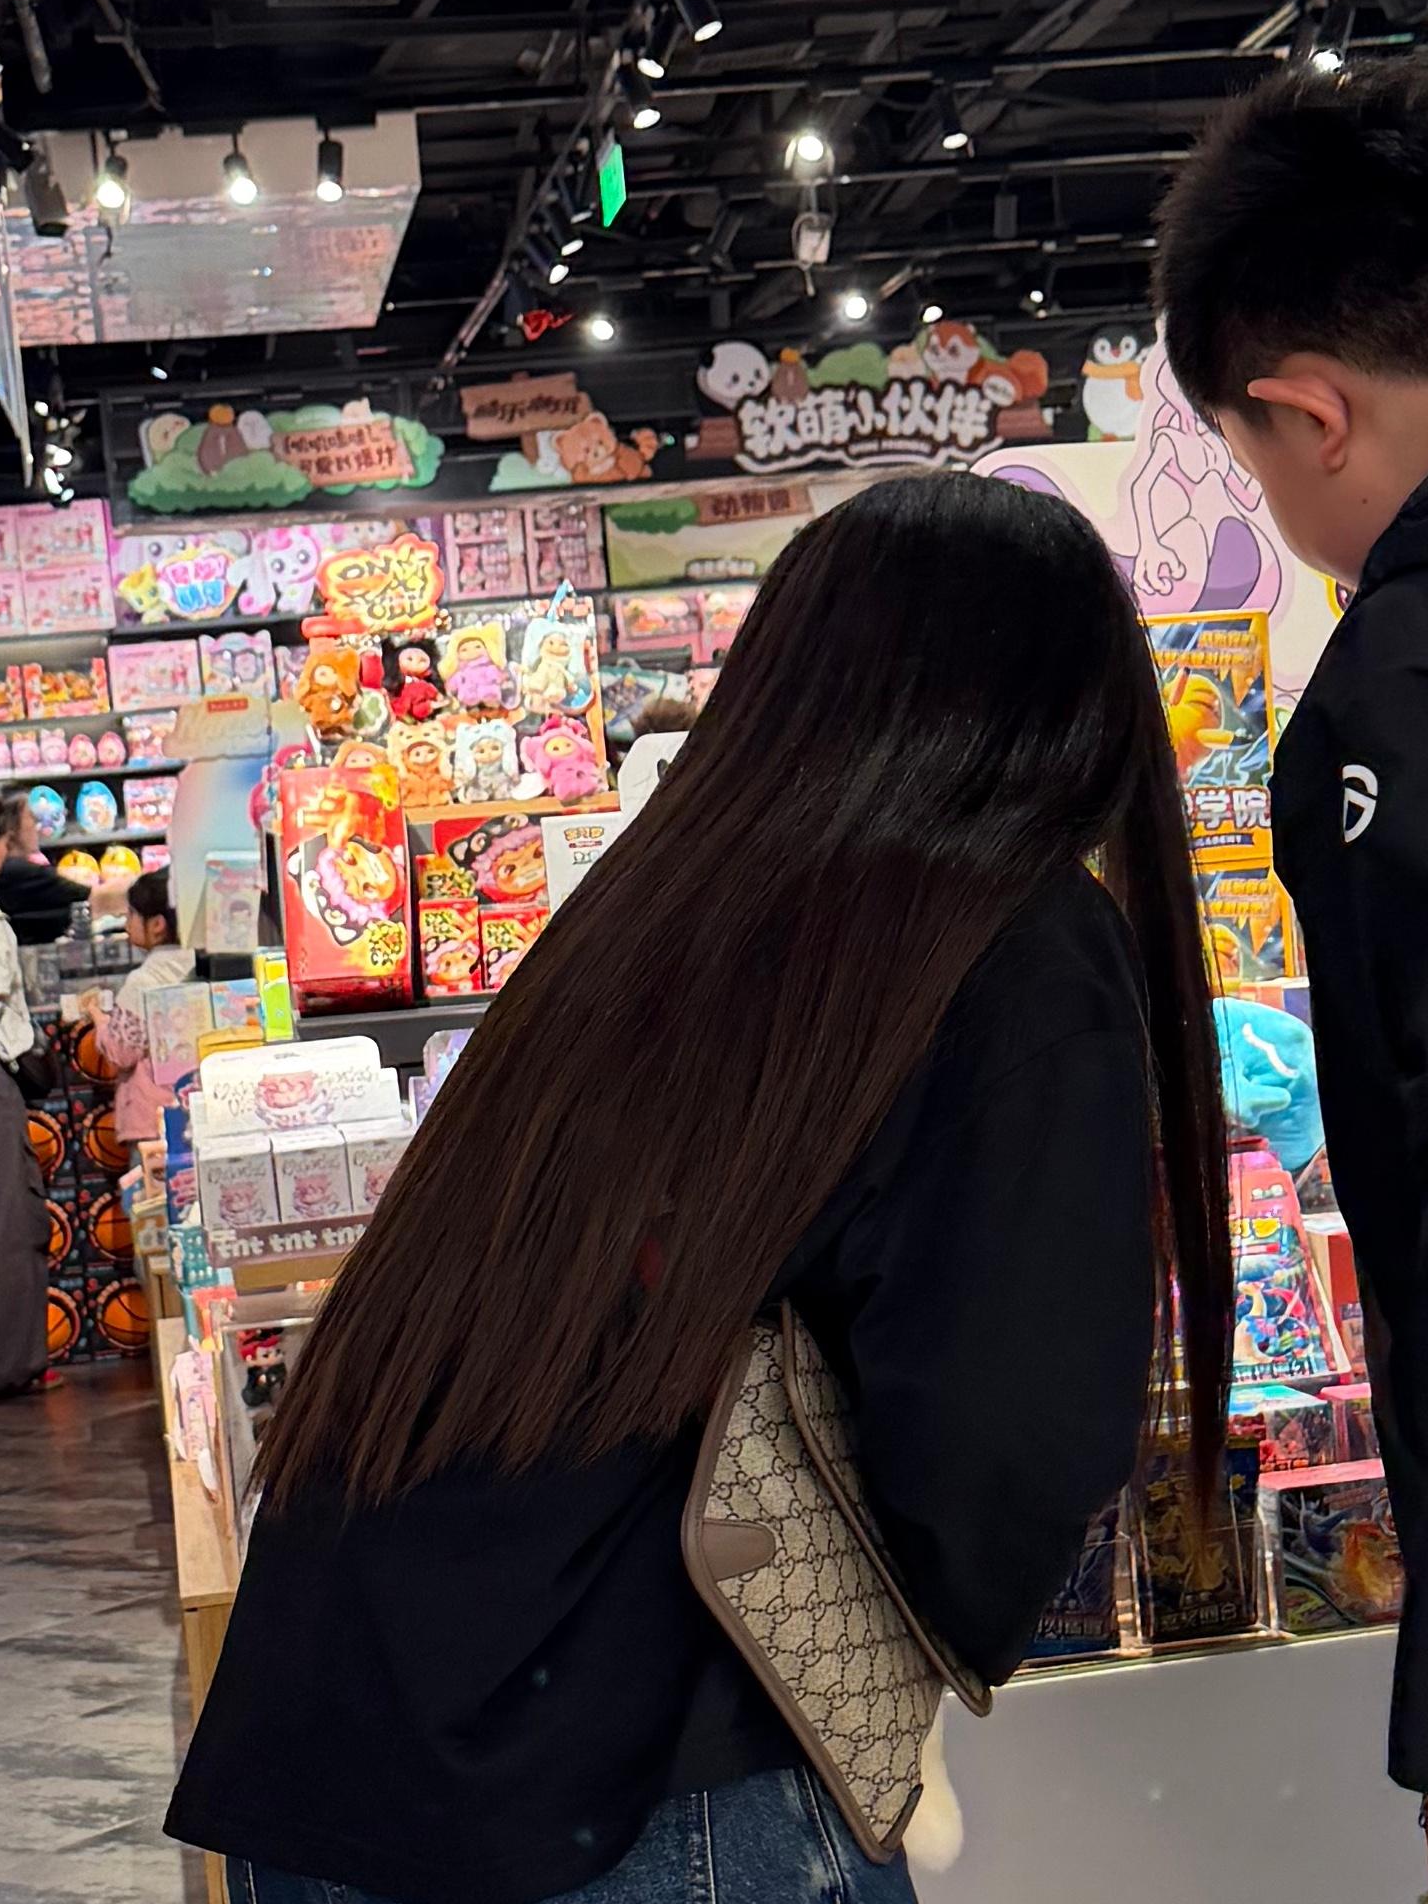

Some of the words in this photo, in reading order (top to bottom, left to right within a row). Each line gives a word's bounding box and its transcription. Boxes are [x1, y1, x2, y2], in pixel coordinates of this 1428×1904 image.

[738, 380, 993, 459] 软萌小伙伴
[269, 1229, 318, 1253] tnt
